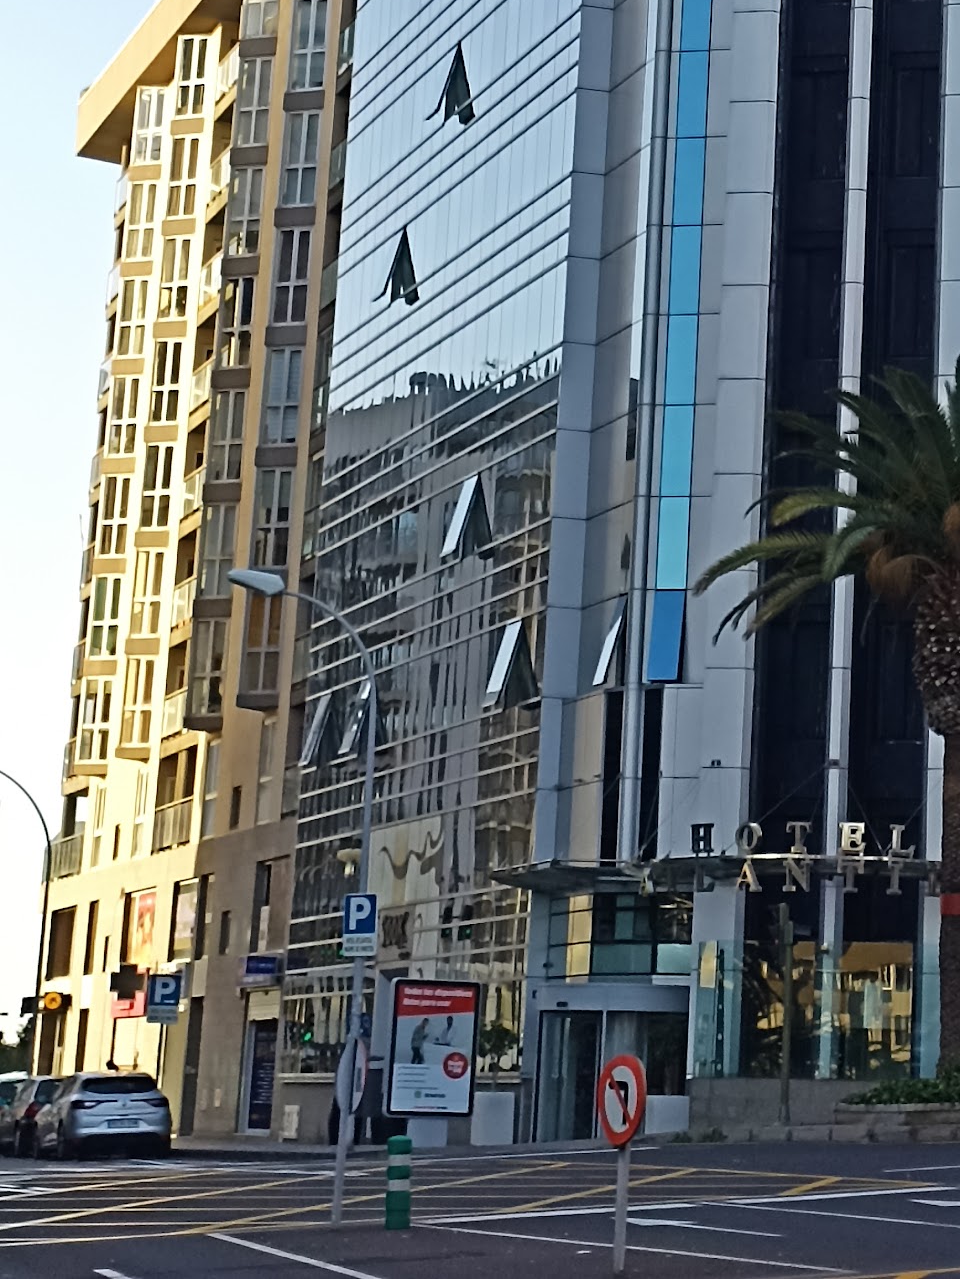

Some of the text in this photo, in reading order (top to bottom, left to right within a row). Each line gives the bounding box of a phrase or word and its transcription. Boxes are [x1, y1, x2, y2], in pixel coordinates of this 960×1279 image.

[690, 822, 915, 862] HOTEL
[348, 896, 372, 931] P
[154, 976, 177, 1004] P
